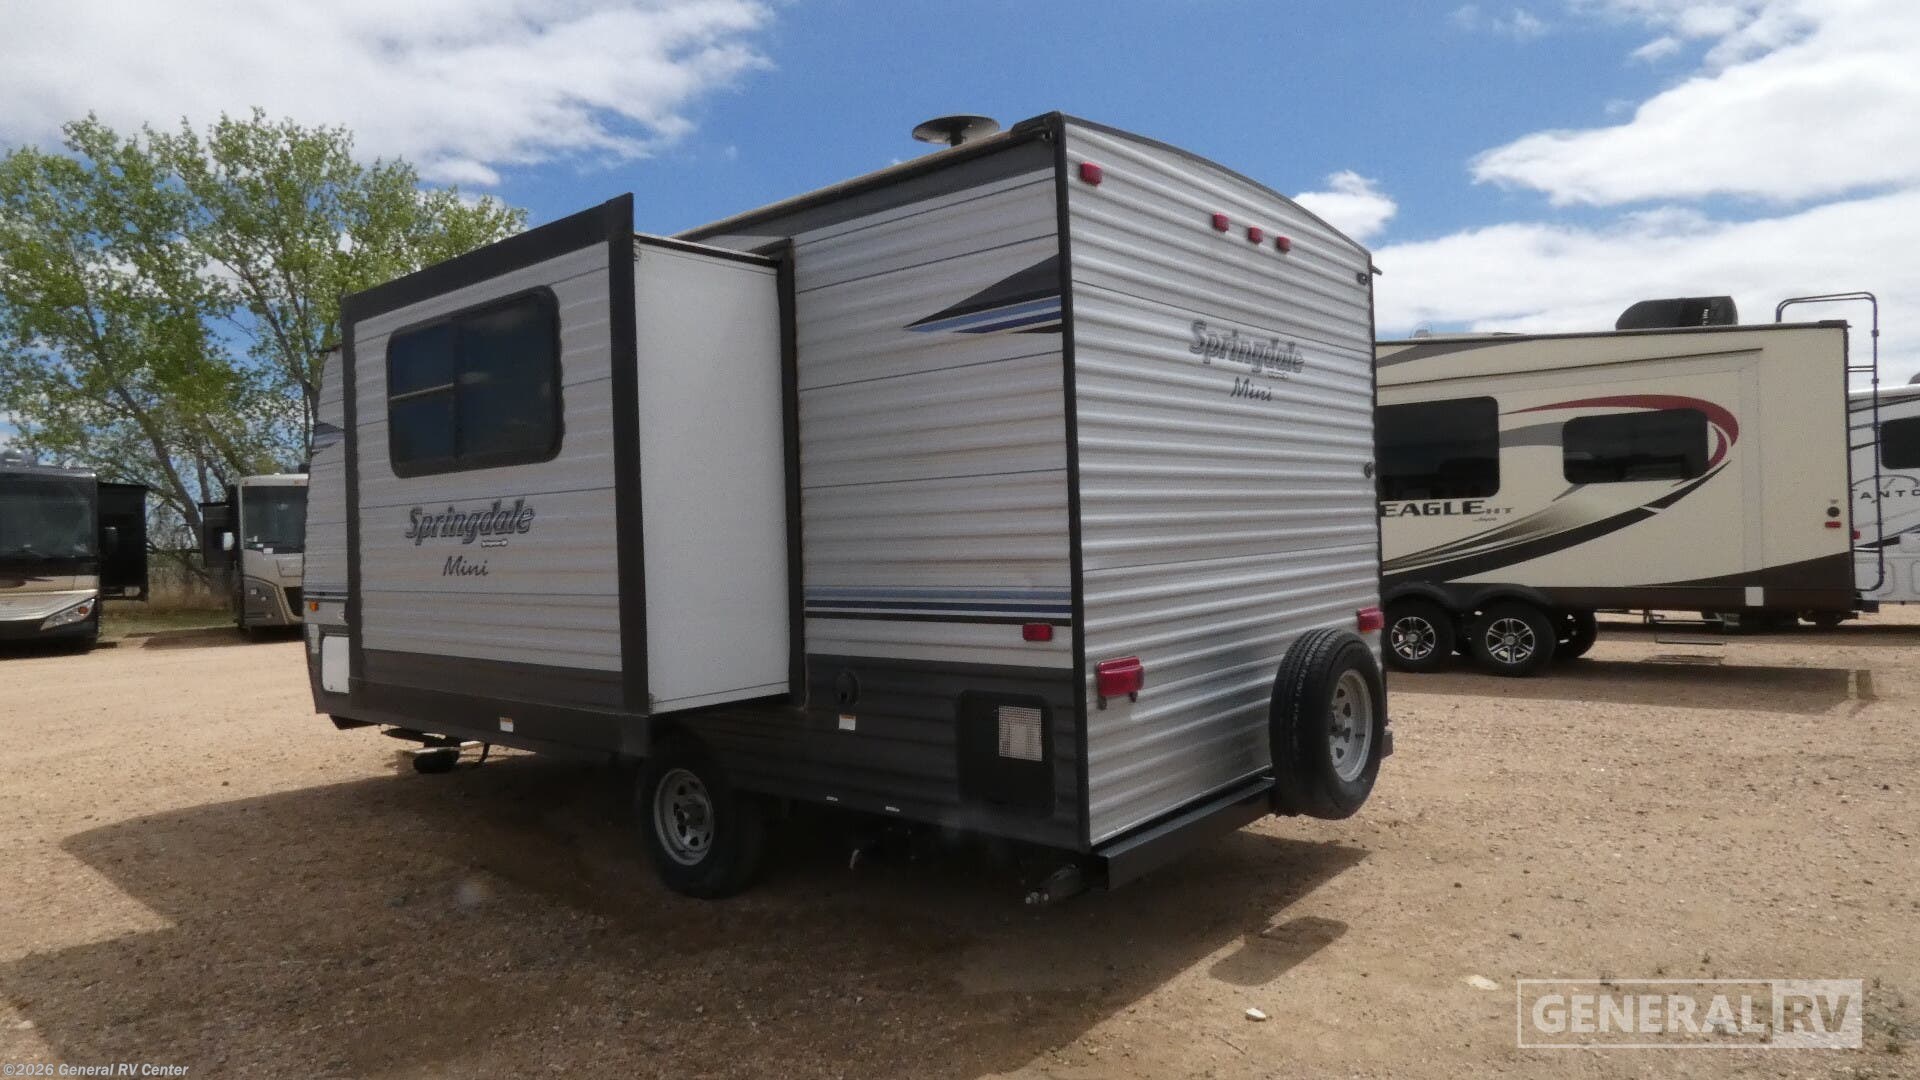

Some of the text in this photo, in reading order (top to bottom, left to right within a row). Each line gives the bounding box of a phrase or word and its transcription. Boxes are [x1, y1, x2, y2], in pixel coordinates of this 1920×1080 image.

[1189, 319, 1305, 374] Springdale
[1230, 376, 1272, 401] Mini
[1380, 500, 1485, 517] EAGLE
[405, 497, 535, 546] Springdale
[443, 555, 488, 576] Mini
